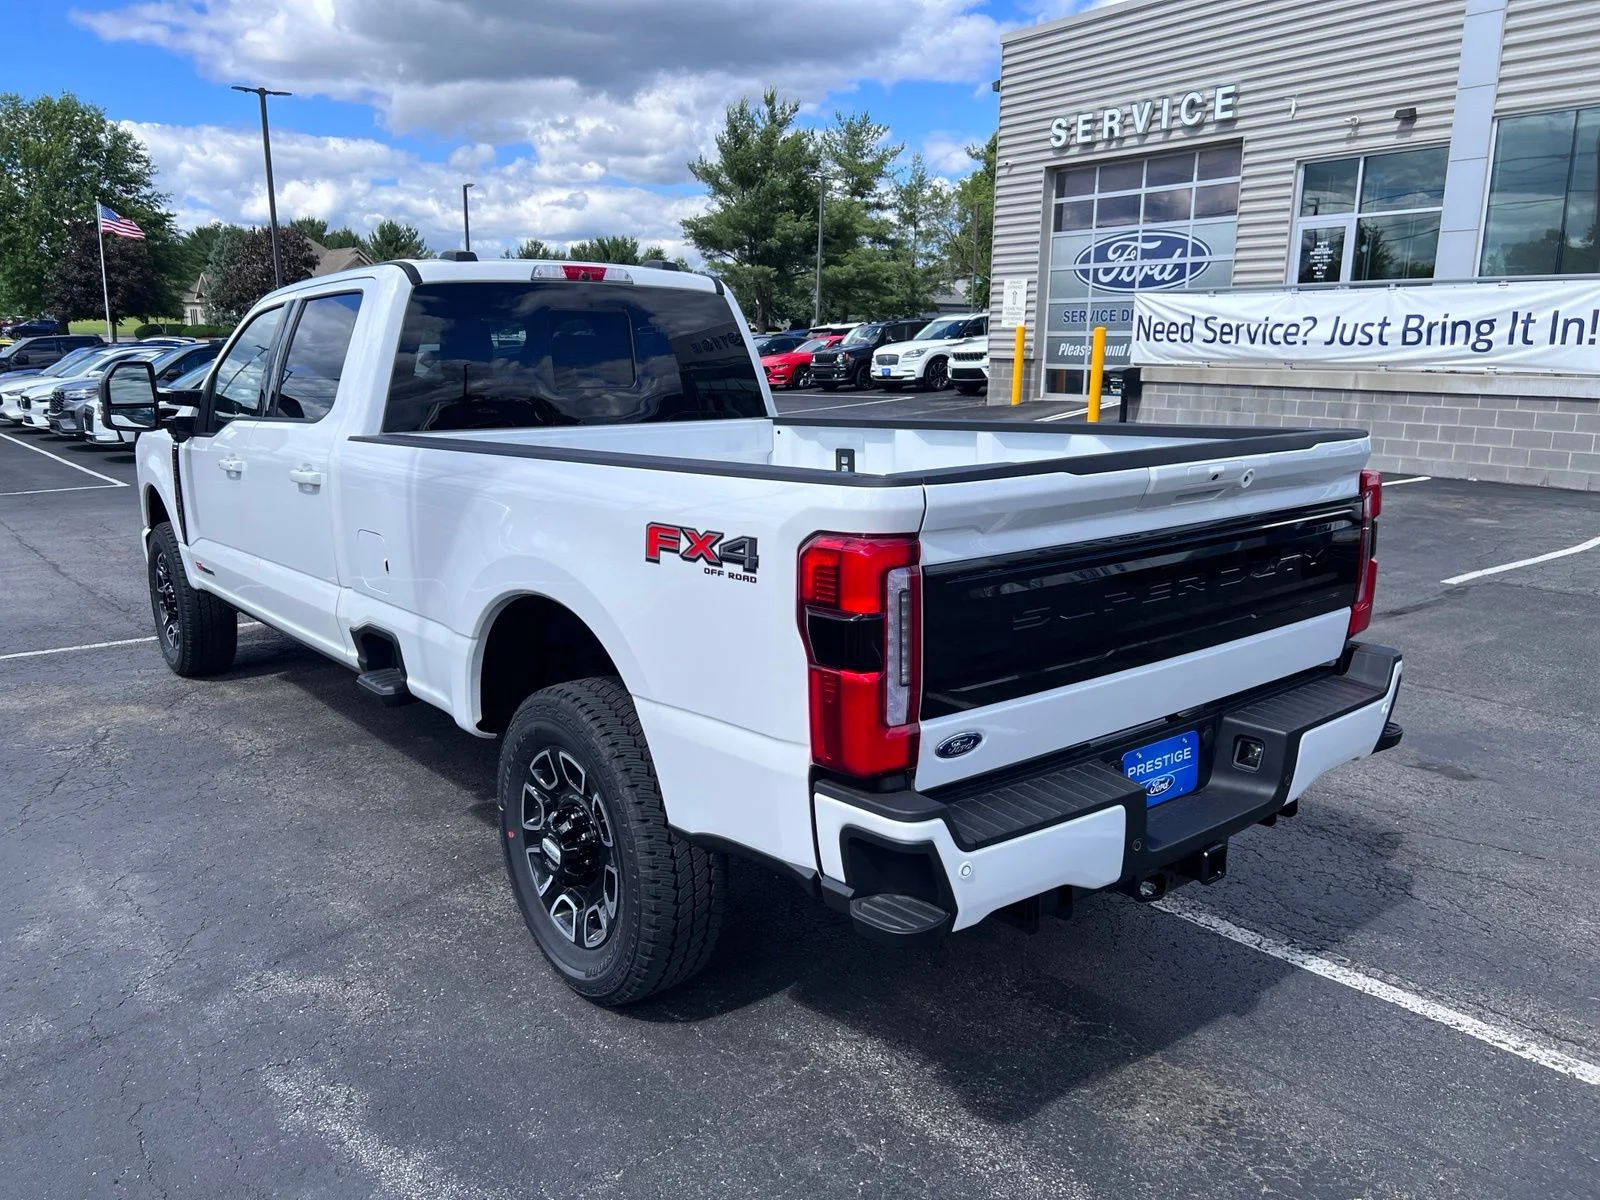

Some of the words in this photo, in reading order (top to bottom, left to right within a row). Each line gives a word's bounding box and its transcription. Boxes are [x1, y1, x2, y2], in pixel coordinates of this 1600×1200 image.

[1050, 84, 1237, 148] SERVICE
[1098, 240, 1182, 283] Ford
[1136, 315, 1196, 343] Need
[1202, 316, 1318, 346] Service?
[1324, 315, 1391, 346] Just
[1401, 313, 1497, 353] Bring
[1508, 311, 1537, 346] It
[1549, 309, 1600, 346] In!
[645, 522, 759, 574] FX4
[703, 567, 725, 577] OFF
[728, 571, 758, 584] ROAD
[947, 737, 974, 755] Ford
[1127, 747, 1192, 778] PRESTIGE
[1149, 777, 1170, 794] Ford
